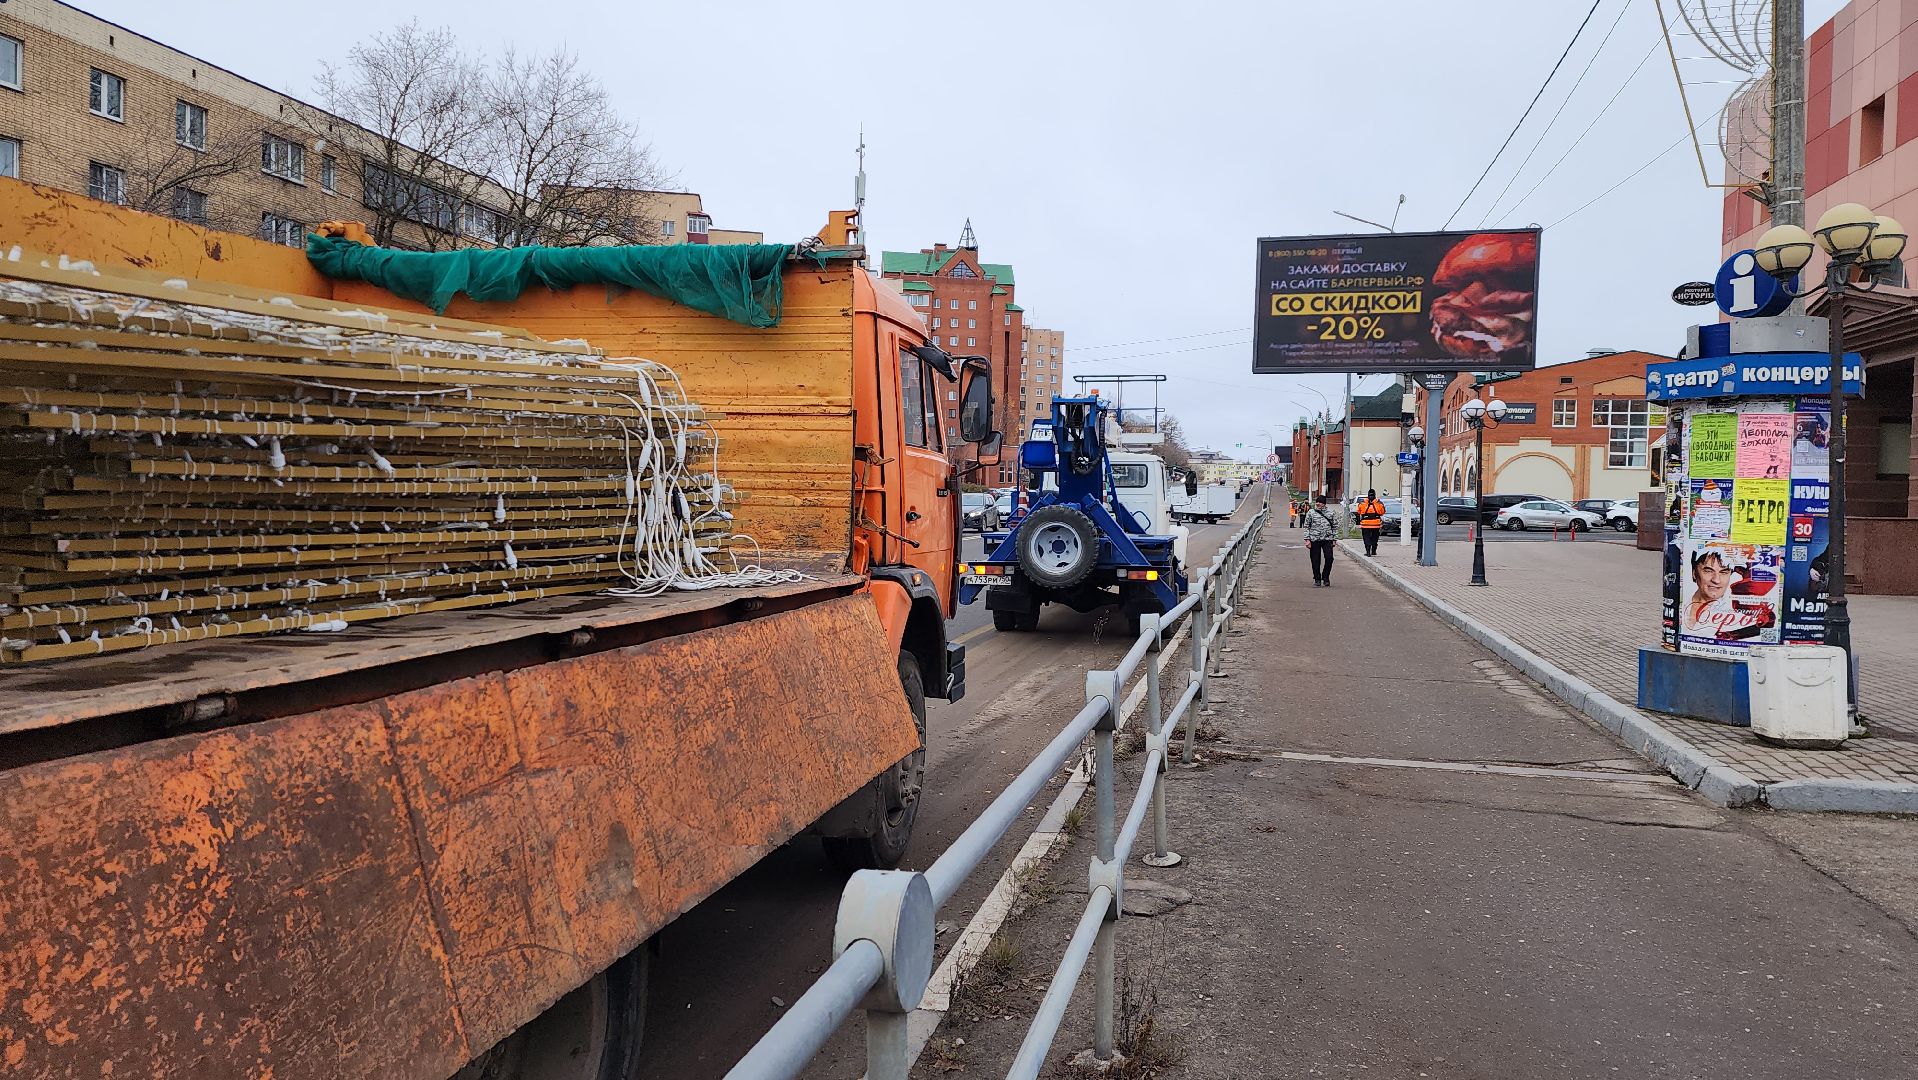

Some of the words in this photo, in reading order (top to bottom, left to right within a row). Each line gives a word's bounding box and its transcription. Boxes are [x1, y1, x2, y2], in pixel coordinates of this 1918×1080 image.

[1288, 265, 1340, 275] ЗАКАЖИ
[1341, 262, 1407, 275] ДОСТАВКУ
[1271, 280, 1288, 290] НА
[1289, 278, 1329, 289] САЙТЕ
[1330, 275, 1425, 289] БАРПЕРВЫЙ.РФ
[1275, 296, 1305, 313] СО
[1309, 291, 1418, 313] СКИДКОЙ
[1306, 316, 1386, 341] -20%
[1664, 369, 1720, 389] театр
[1706, 430, 1719, 440] ЭТИ
[1692, 440, 1735, 451] СВОБОДНЫЕ
[1695, 452, 1731, 462] БАБОЧКИ
[1737, 499, 1785, 524] РЕТРО
[1794, 523, 1813, 536] 30
